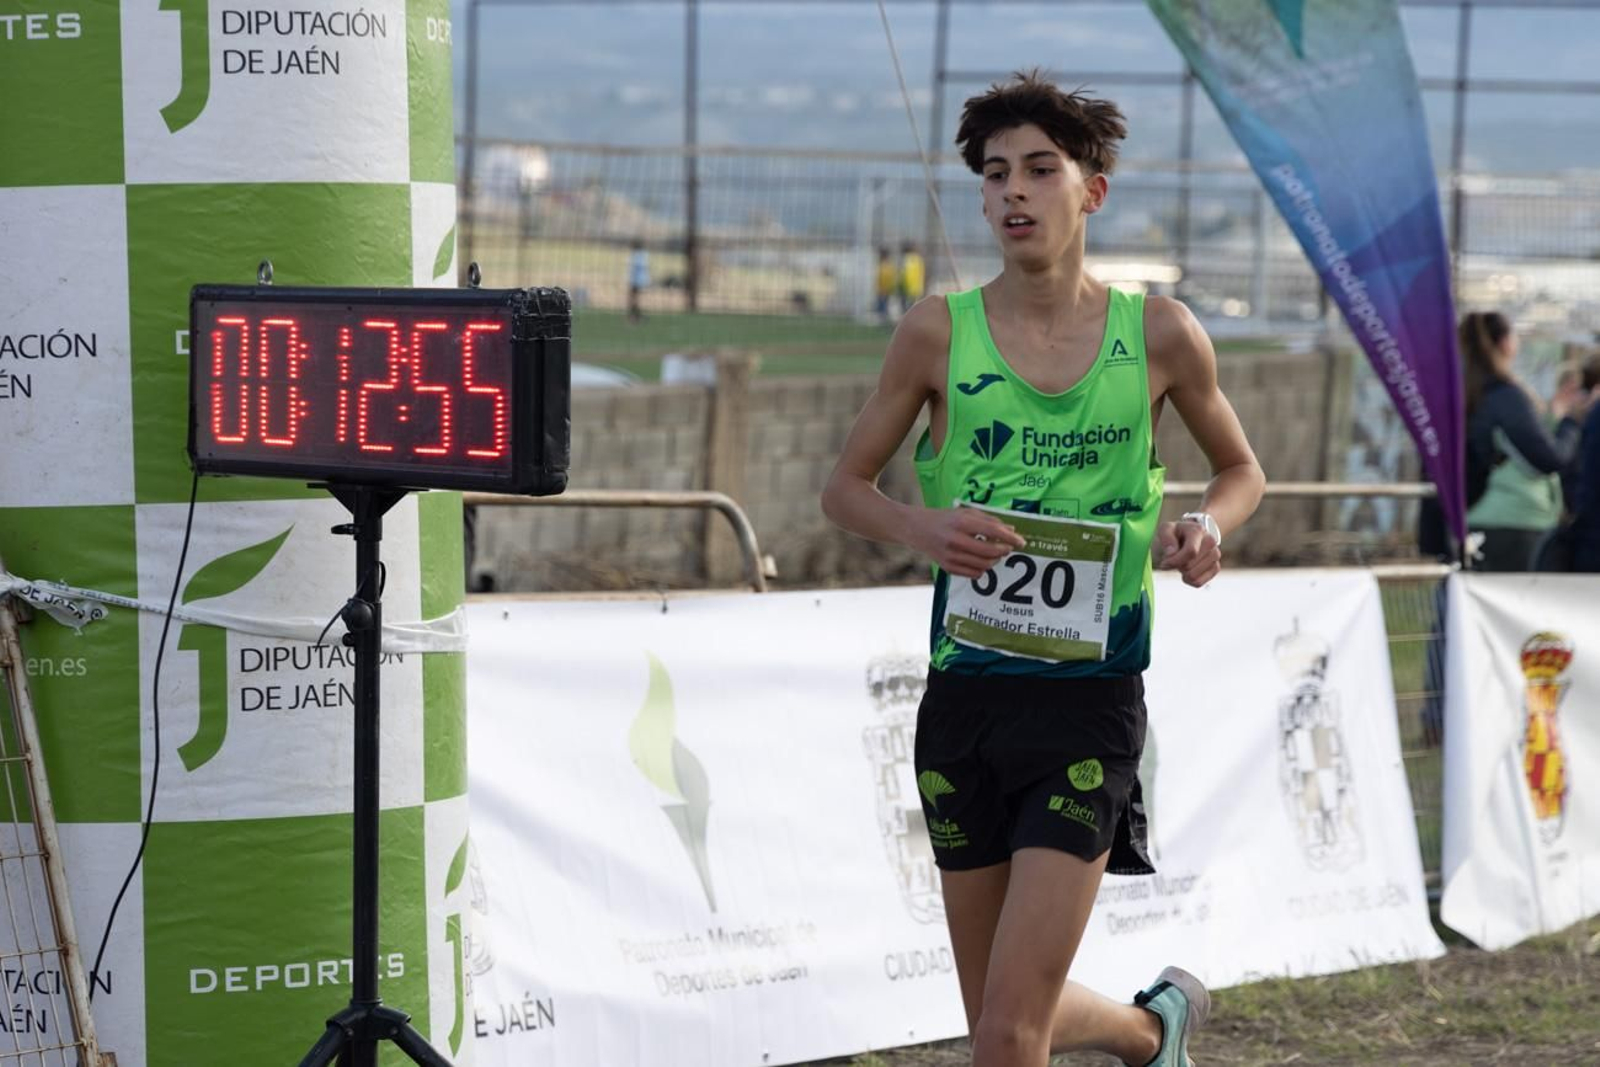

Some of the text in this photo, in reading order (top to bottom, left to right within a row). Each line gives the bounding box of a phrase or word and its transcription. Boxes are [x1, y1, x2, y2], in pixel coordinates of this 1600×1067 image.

[222, 8, 387, 38] DIPUTACIÓN
[223, 45, 340, 75] DE JAÉN
[0, 328, 97, 359] ACIÓN
[1022, 424, 1131, 448] Fundación
[1021, 446, 1099, 470] Unicaja
[1038, 540, 1069, 553] través
[968, 607, 1024, 633] Herrador
[1027, 622, 1082, 640] Estrella
[999, 603, 1035, 618] Jesus
[240, 644, 404, 673] DIPUTACN
[240, 678, 355, 712] DE JAÉN
[189, 953, 405, 994] DEPORTS
[884, 947, 953, 981] CIUDAD
[0, 970, 111, 995] TACIN
[495, 990, 556, 1036] JAÉN
